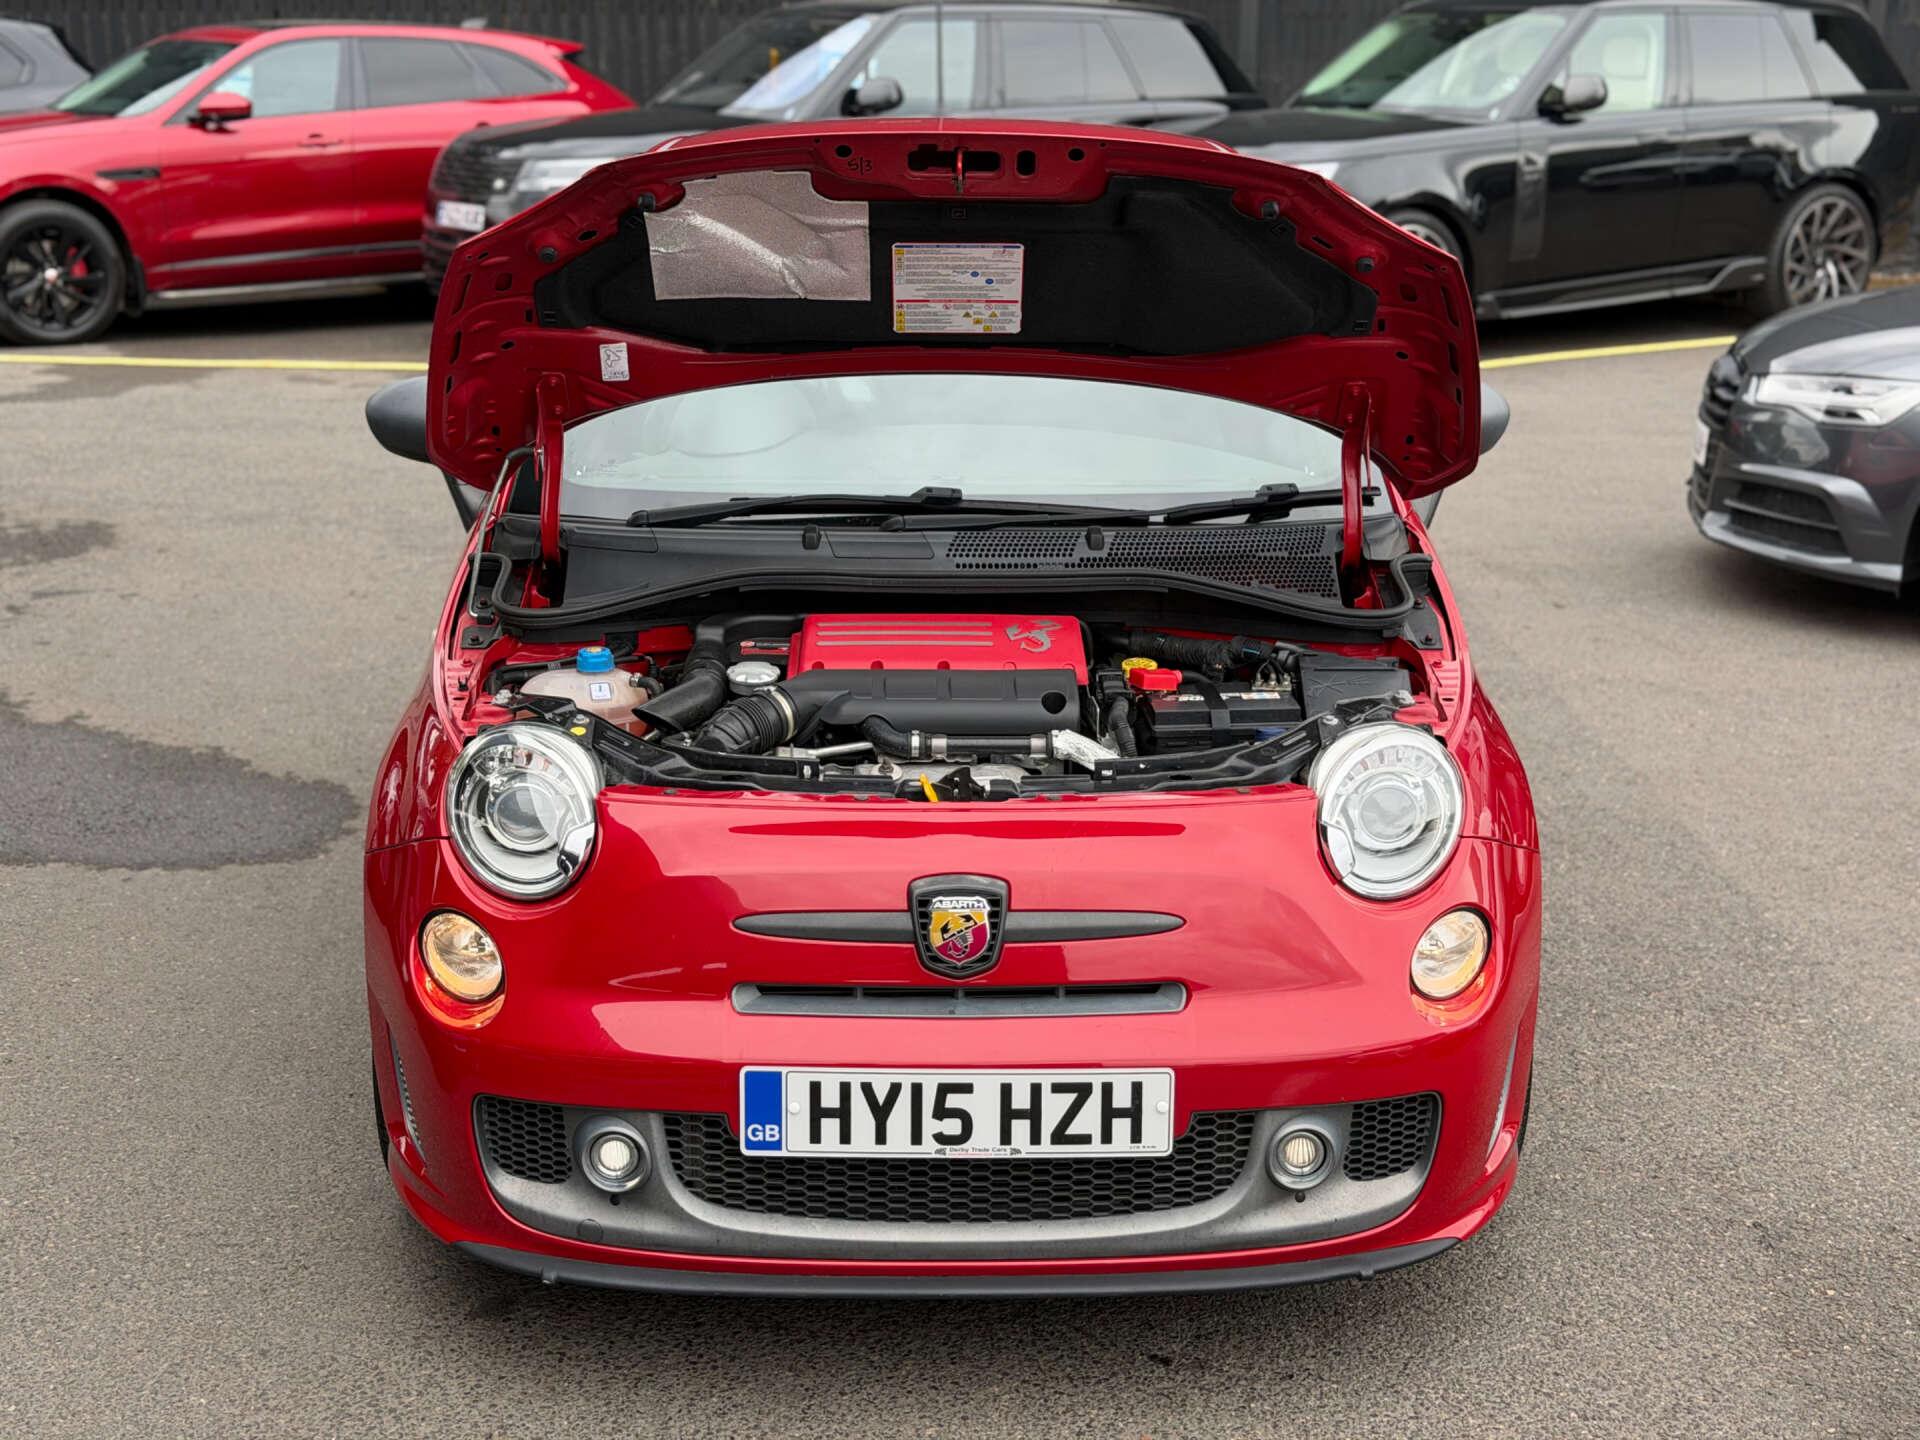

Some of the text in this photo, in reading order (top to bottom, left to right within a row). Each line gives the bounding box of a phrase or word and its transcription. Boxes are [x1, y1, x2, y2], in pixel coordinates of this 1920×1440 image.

[933, 900, 985, 909] ABARTH
[808, 1081, 1143, 1146] HY15 HZH
[747, 1124, 780, 1142] GB
